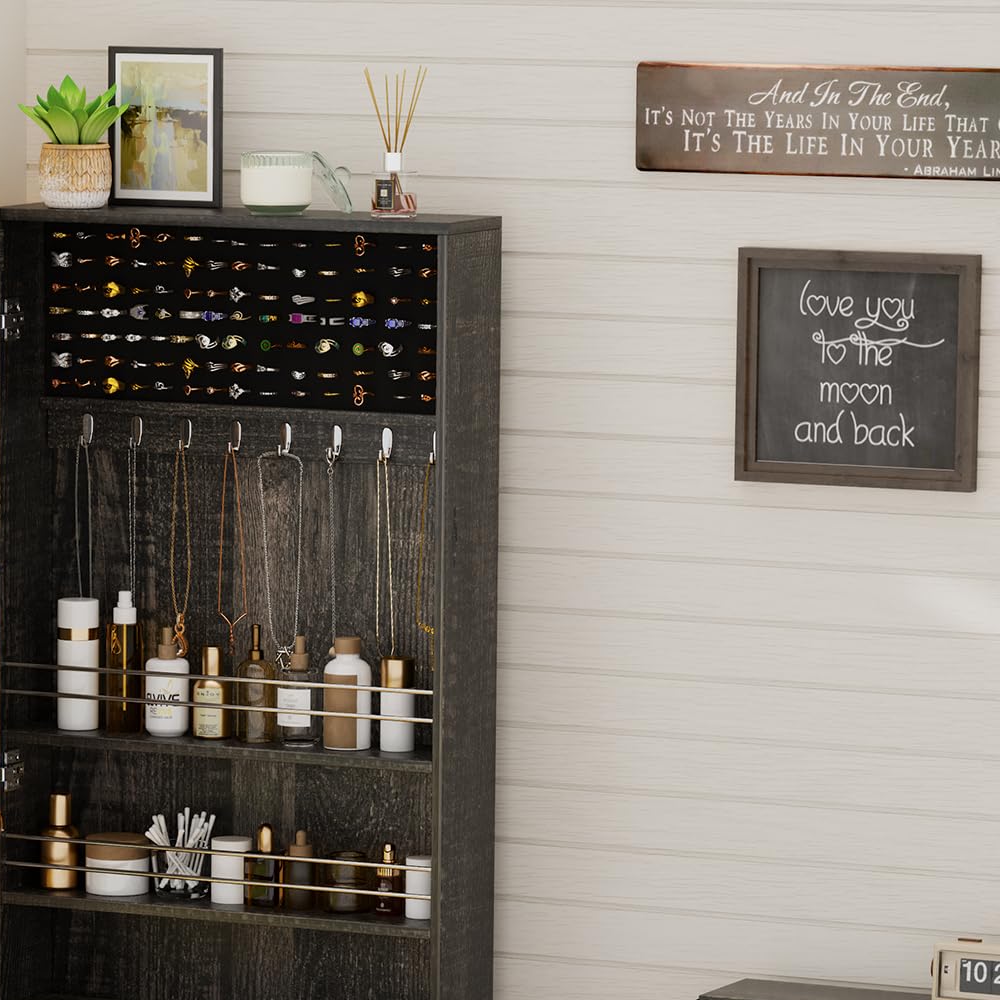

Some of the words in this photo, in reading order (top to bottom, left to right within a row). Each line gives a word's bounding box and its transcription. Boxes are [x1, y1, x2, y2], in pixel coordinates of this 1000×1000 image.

[748, 78, 809, 105] And
[809, 78, 841, 108] In
[847, 80, 892, 107] The
[896, 81, 950, 111] End,
[645, 106, 674, 126] IT'S
[681, 108, 716, 128] NOT
[724, 109, 757, 129] THE
[764, 110, 813, 130] YEARS
[821, 112, 840, 130] IN
[848, 112, 893, 132] YOUR
[902, 113, 936, 132] LIFE
[944, 114, 990, 133] THAT
[684, 127, 722, 153] IT'S
[732, 130, 774, 154] THE
[785, 132, 829, 156] LIFE
[840, 133, 864, 157] IN
[875, 134, 934, 158] YOUR
[913, 163, 977, 177] ABRAHAM
[799, 279, 854, 318] love
[854, 296, 915, 332] you
[811, 328, 847, 366] to
[819, 381, 892, 406] moon
[794, 410, 845, 444] and
[850, 411, 915, 448] back
[962, 960, 988, 984] 10
